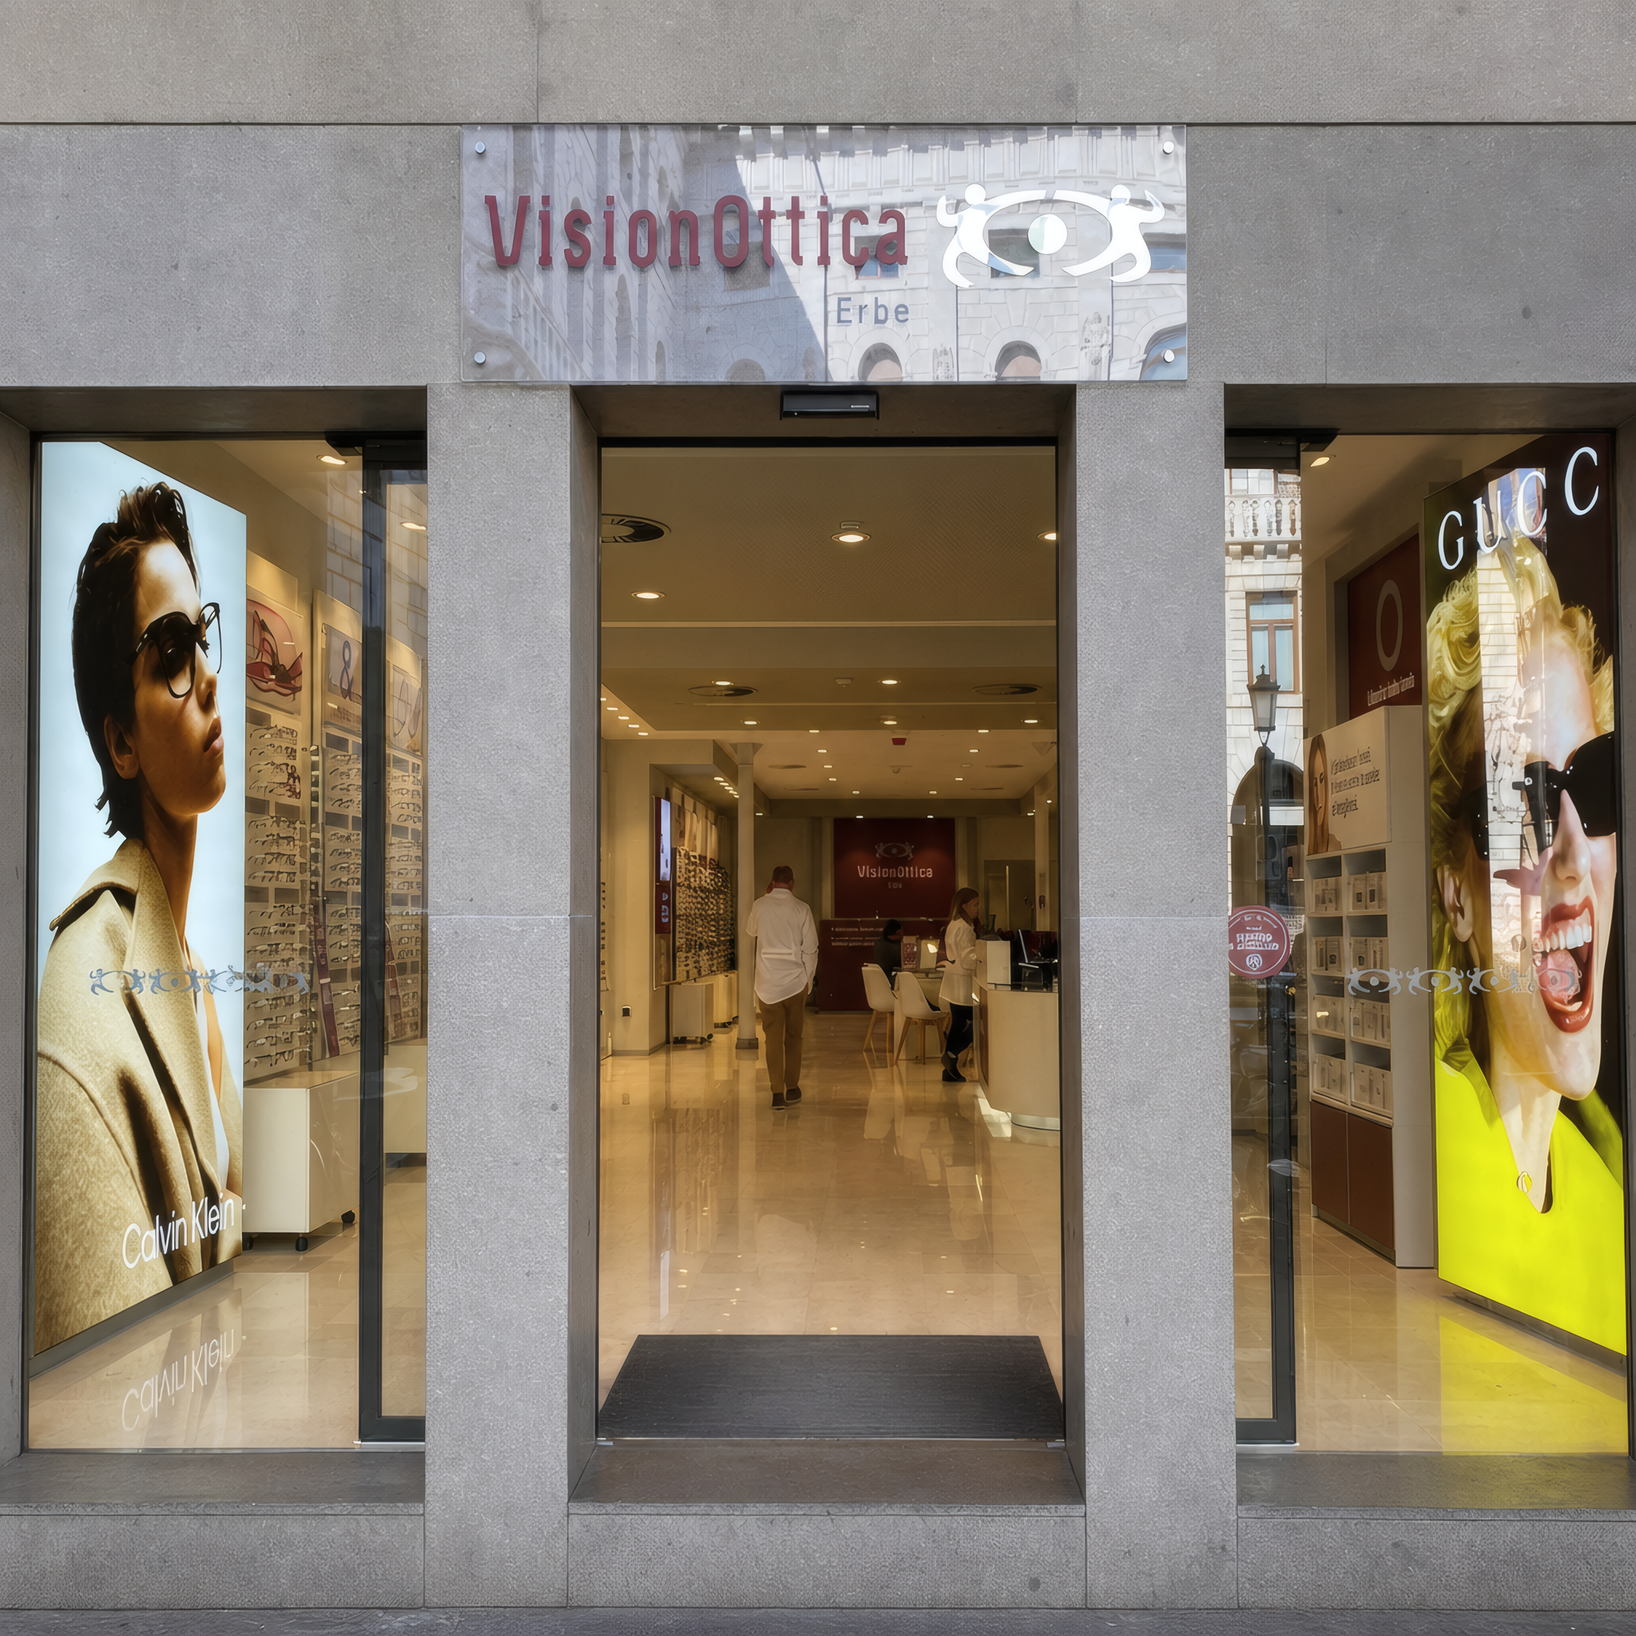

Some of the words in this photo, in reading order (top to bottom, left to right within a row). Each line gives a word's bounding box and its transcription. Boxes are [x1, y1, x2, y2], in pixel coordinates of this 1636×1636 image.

[484, 194, 908, 268] VisionOttica
[836, 296, 909, 325] Erbe
[122, 1210, 188, 1269] Calvin
[191, 1192, 235, 1243] Klein
